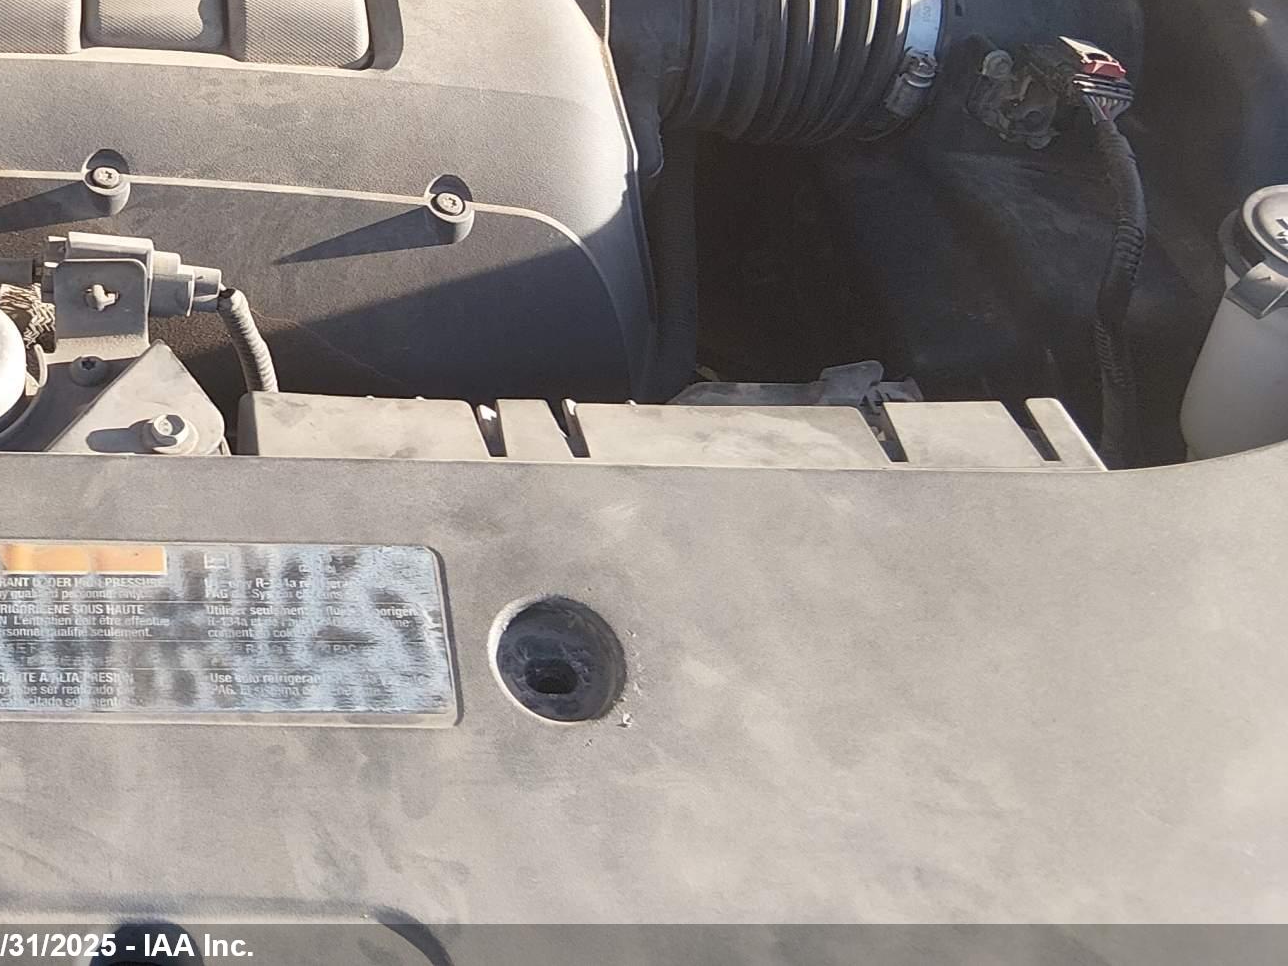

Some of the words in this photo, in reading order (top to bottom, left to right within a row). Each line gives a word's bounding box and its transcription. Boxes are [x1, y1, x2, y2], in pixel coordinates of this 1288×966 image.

[72, 604, 104, 614] SOUS
[105, 604, 145, 615] HAUTE
[210, 673, 233, 683] Use
[40, 685, 58, 695] ser
